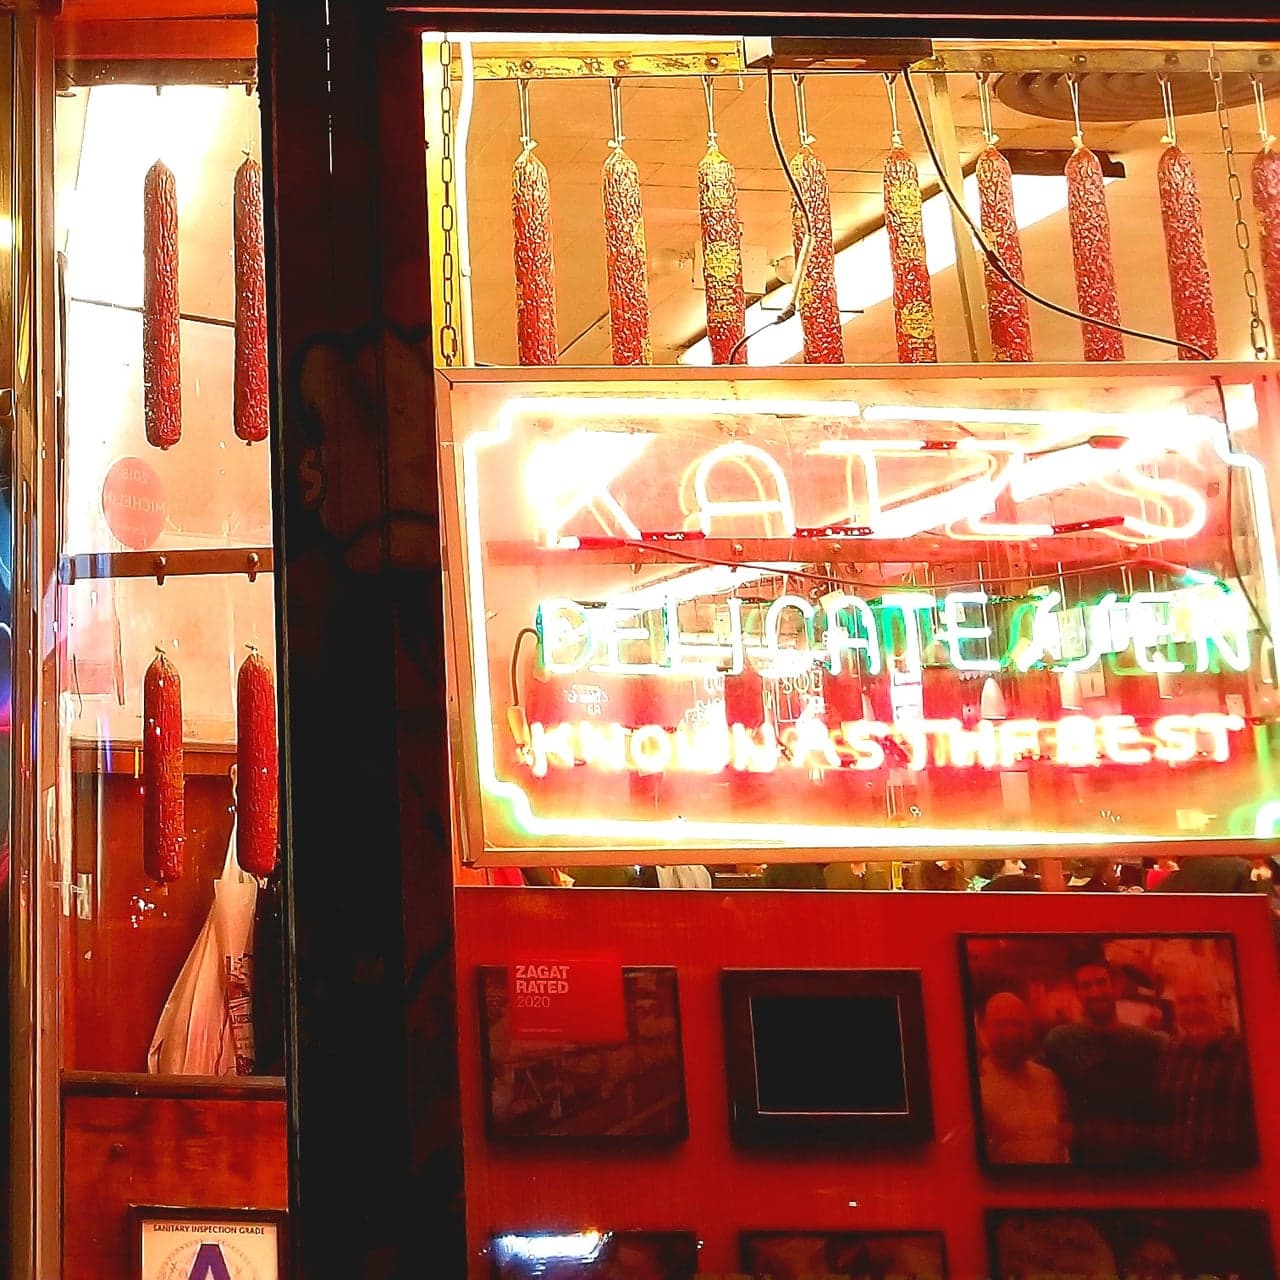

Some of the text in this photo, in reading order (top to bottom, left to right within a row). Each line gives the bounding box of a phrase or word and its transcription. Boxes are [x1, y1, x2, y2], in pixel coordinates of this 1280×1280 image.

[1054, 714, 1246, 767] BEST
[516, 966, 570, 979] ZAGAT
[516, 980, 569, 994] RATED
[517, 996, 551, 1008] 2020
[153, 1224, 265, 1235] SANITARY INSPECTION GRADE
